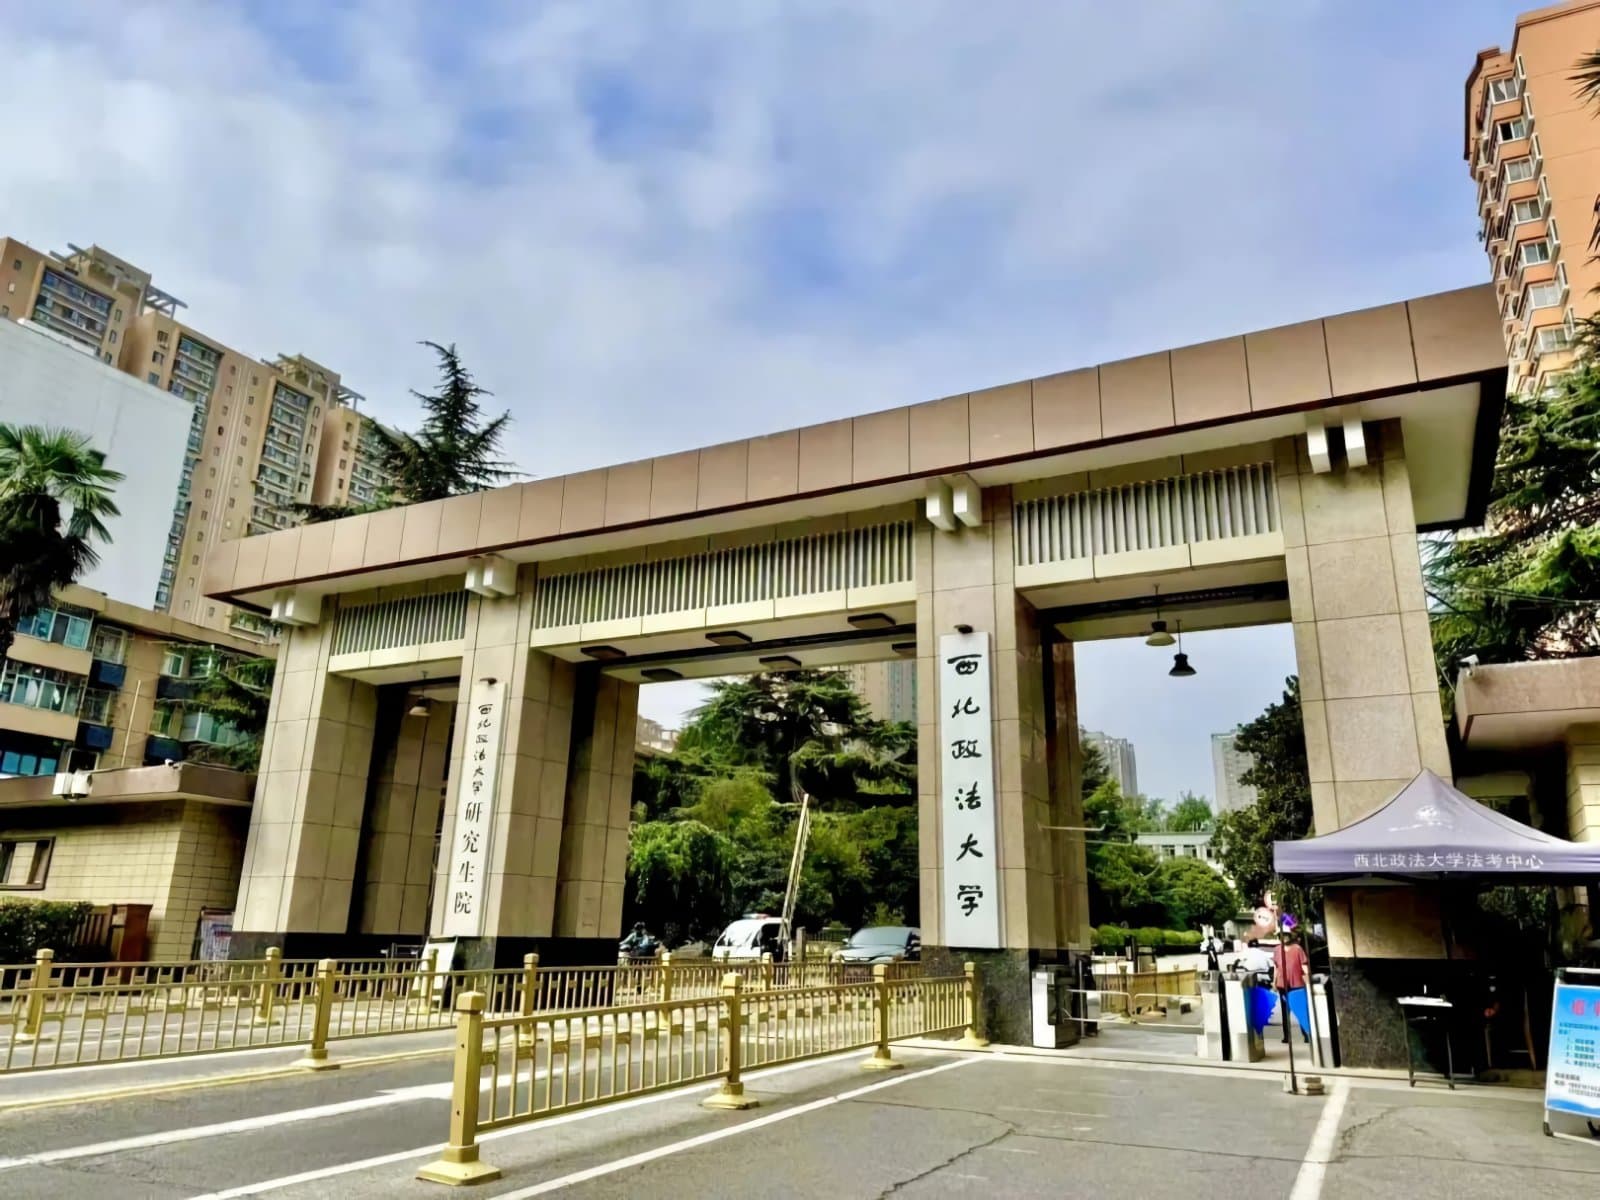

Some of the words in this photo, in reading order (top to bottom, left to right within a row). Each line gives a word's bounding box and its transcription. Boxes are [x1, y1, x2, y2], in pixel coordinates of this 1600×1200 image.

[455, 703, 493, 914] 西北政法大学研究生院
[947, 654, 983, 916] 西北政法大学
[1353, 853, 1544, 869] 西北政法大学法考中心
